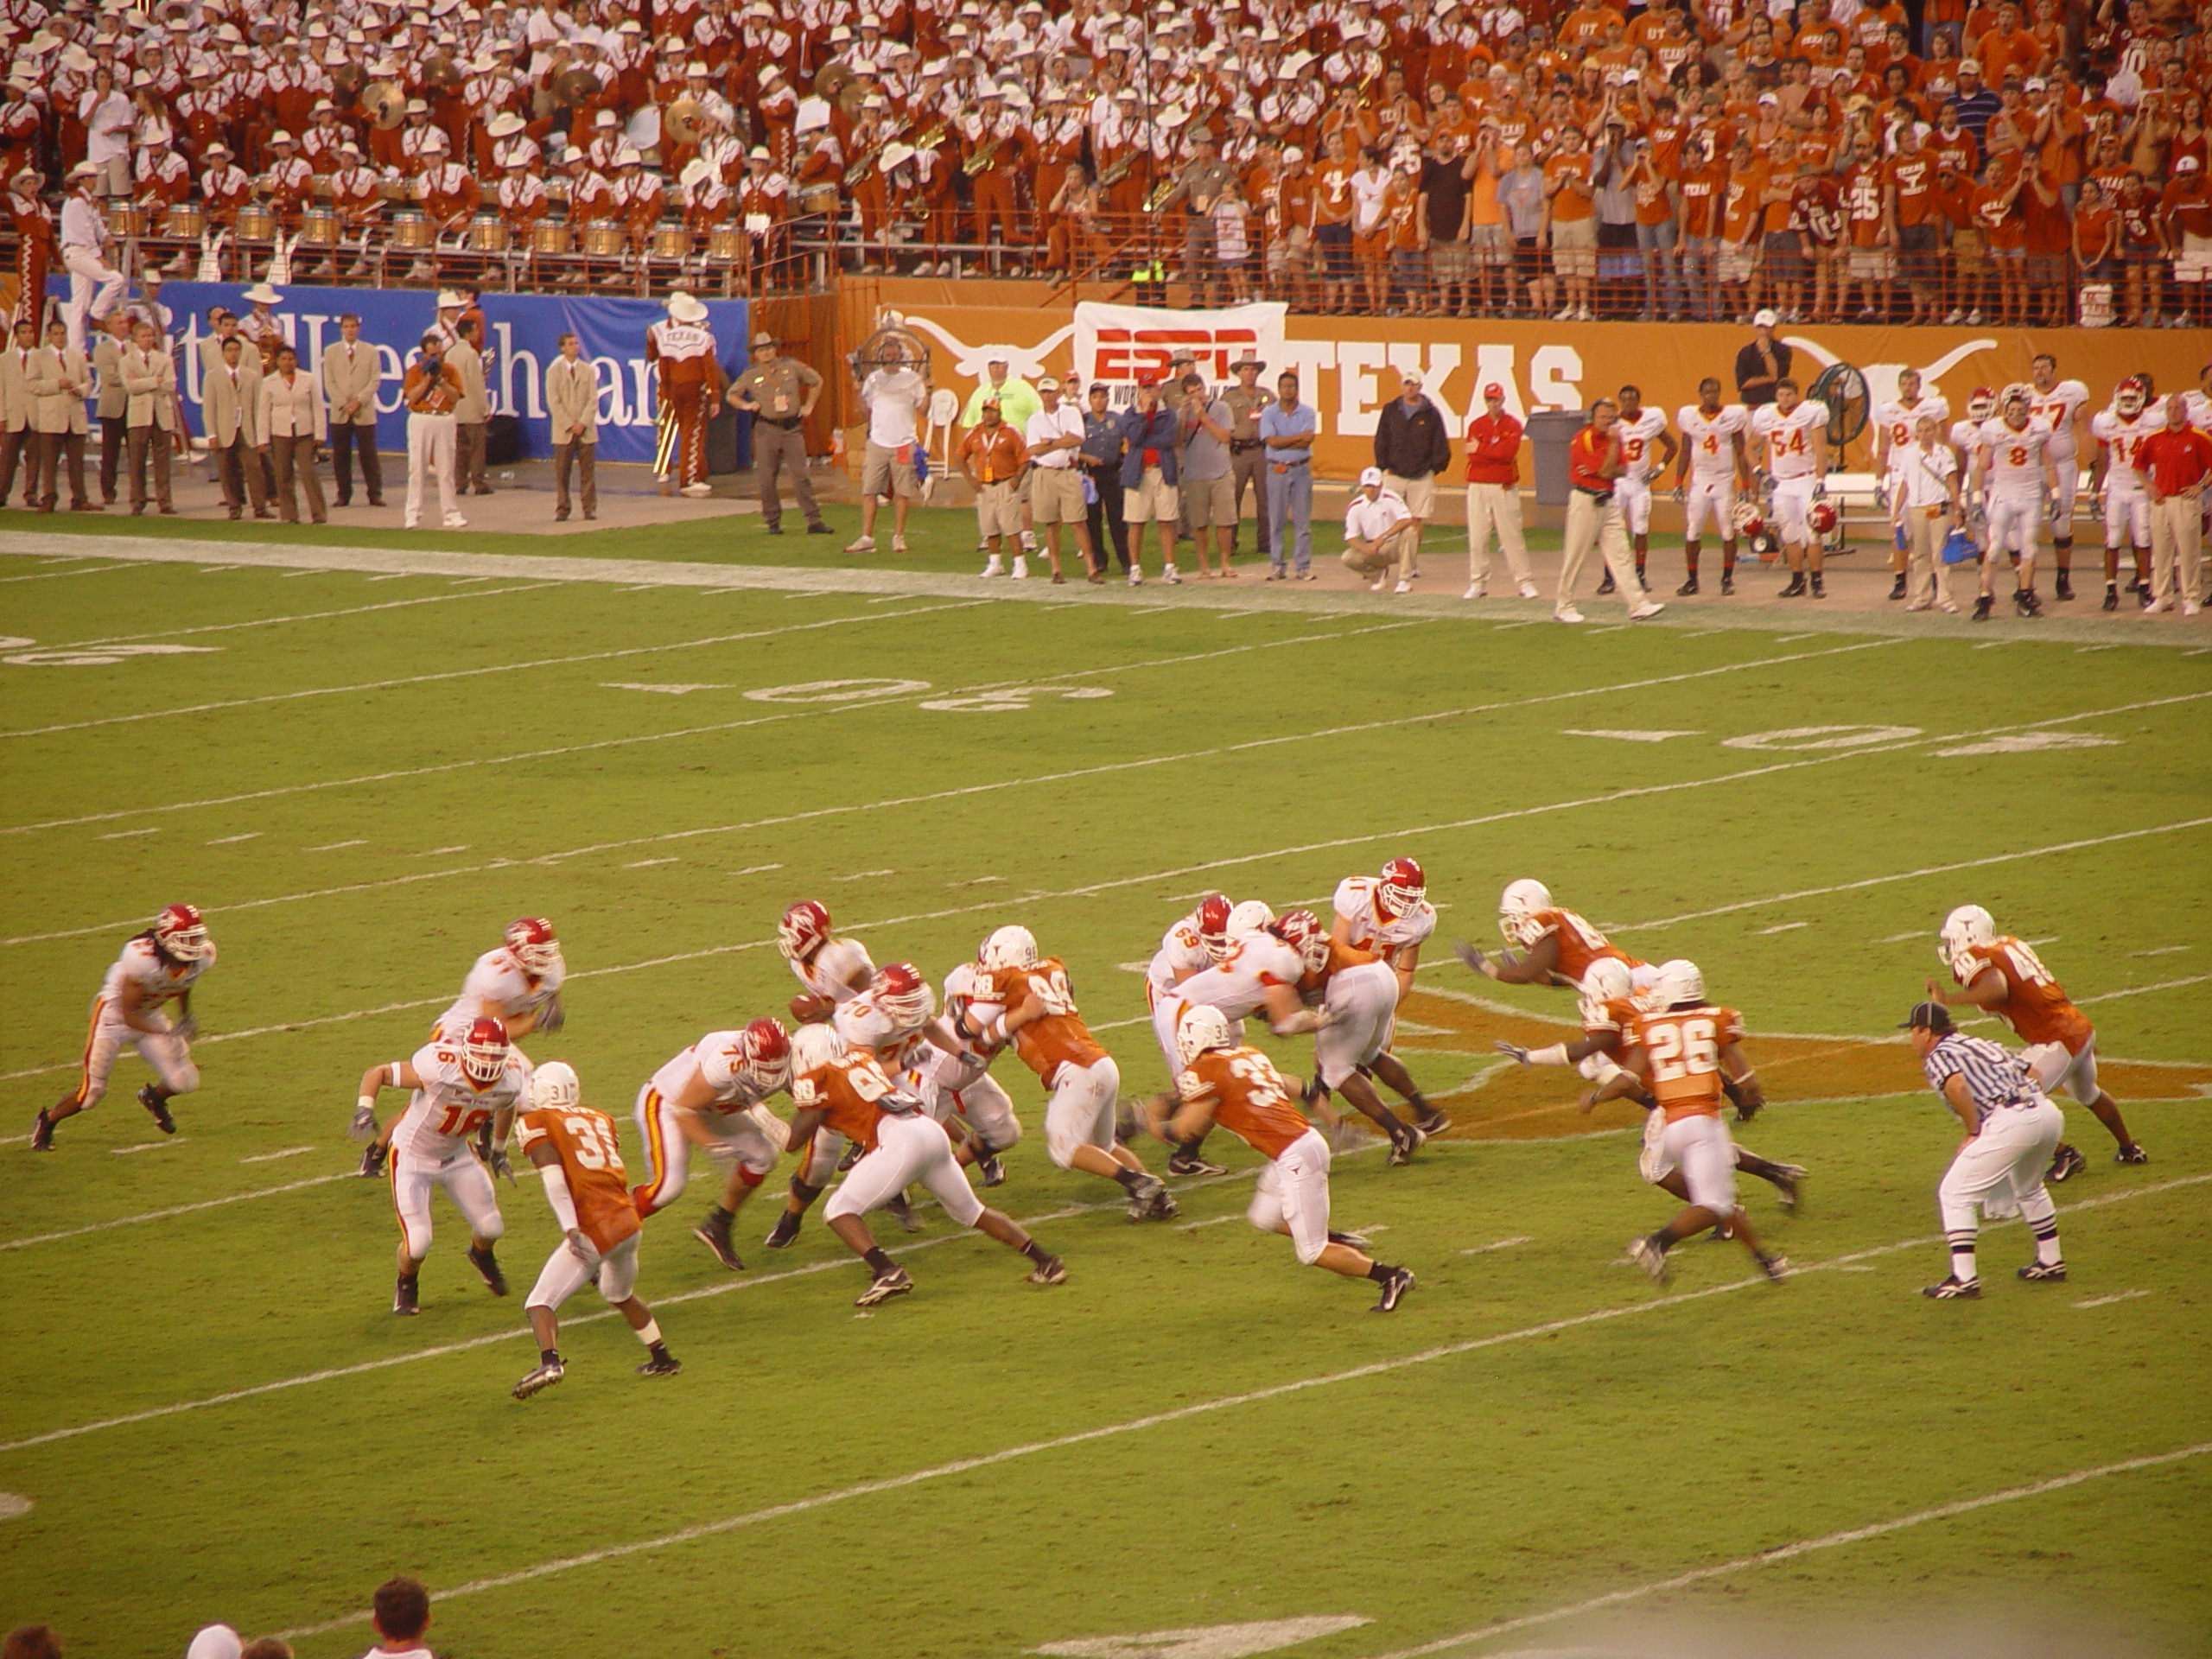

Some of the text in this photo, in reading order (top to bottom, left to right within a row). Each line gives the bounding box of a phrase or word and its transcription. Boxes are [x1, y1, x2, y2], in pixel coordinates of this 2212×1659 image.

[1580, 23, 1598, 35] UT
[1647, 28, 1666, 40] UT
[1685, 183, 1711, 196] TEXAS
[1851, 188, 1879, 220] 25
[1286, 340, 1583, 440] TEXAS
[1703, 434, 1718, 456] 4
[1771, 429, 1805, 457] 54
[2009, 446, 2027, 467] 8
[1174, 926, 1199, 948] 69
[1645, 1020, 1719, 1082] 26
[551, 1084, 569, 1100] 31
